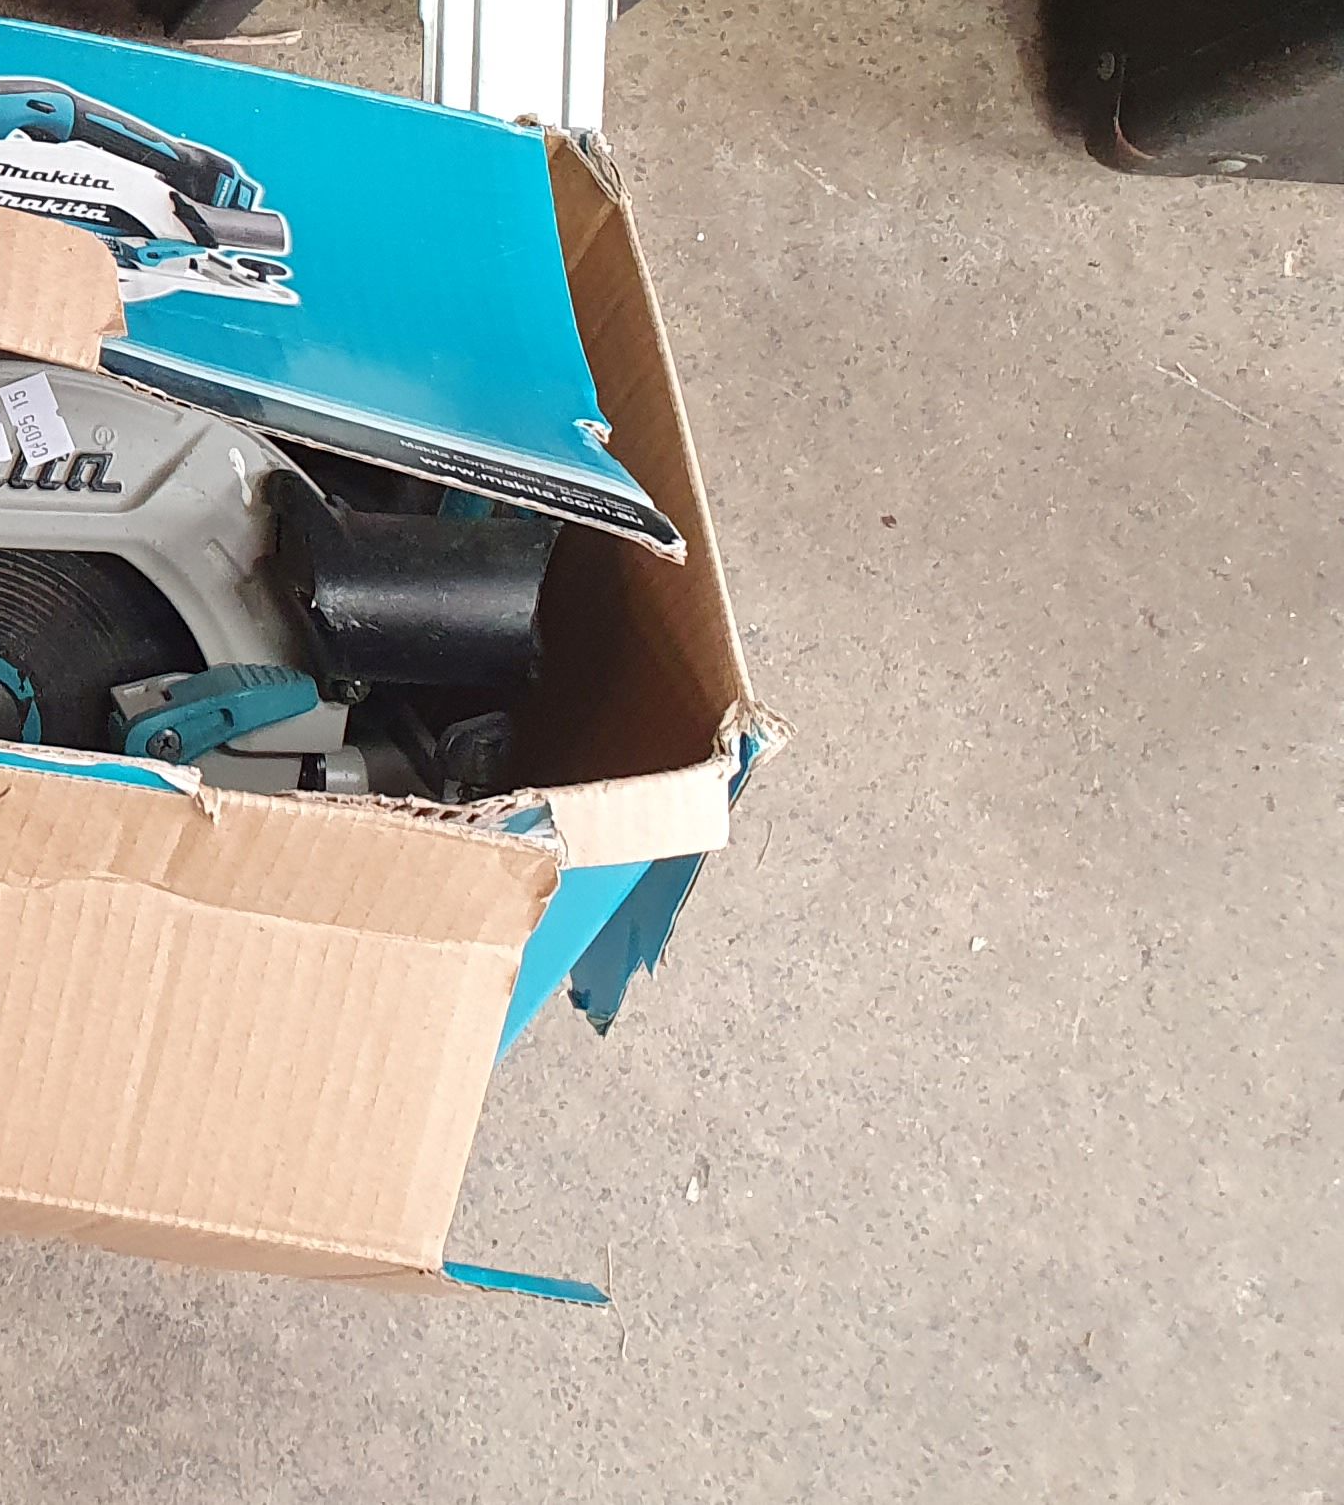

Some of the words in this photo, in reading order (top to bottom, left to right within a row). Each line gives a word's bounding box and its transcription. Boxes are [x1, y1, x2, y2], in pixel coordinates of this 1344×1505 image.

[7, 389, 27, 409] 15
[453, 454, 541, 484] Corporation
[420, 456, 644, 526] www.makita.com.au
